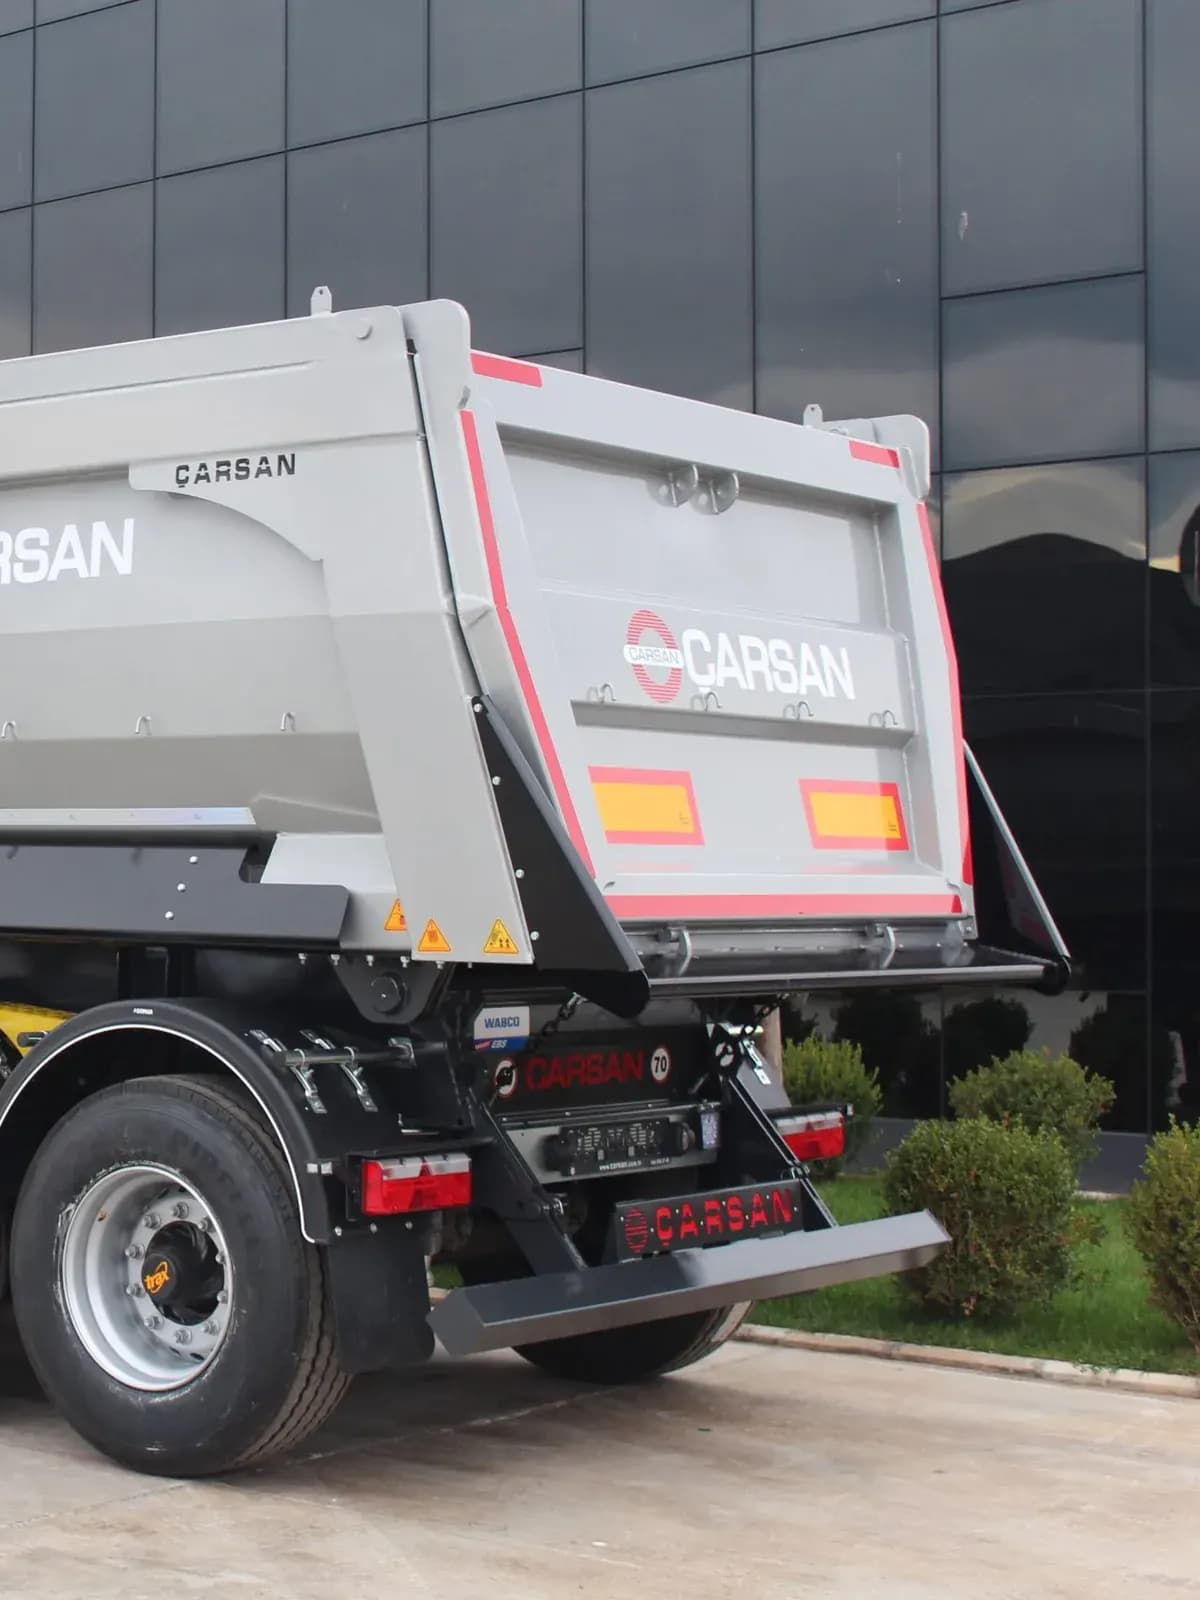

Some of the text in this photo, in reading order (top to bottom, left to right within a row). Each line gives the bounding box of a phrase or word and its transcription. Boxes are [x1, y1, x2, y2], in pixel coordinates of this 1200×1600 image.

[176, 453, 296, 488] ÇARSAN
[682, 629, 856, 699] ÇARSAN
[484, 1016, 520, 1029] WABCO
[654, 1056, 667, 1073] 70
[656, 1188, 793, 1247] ÇARSAN
